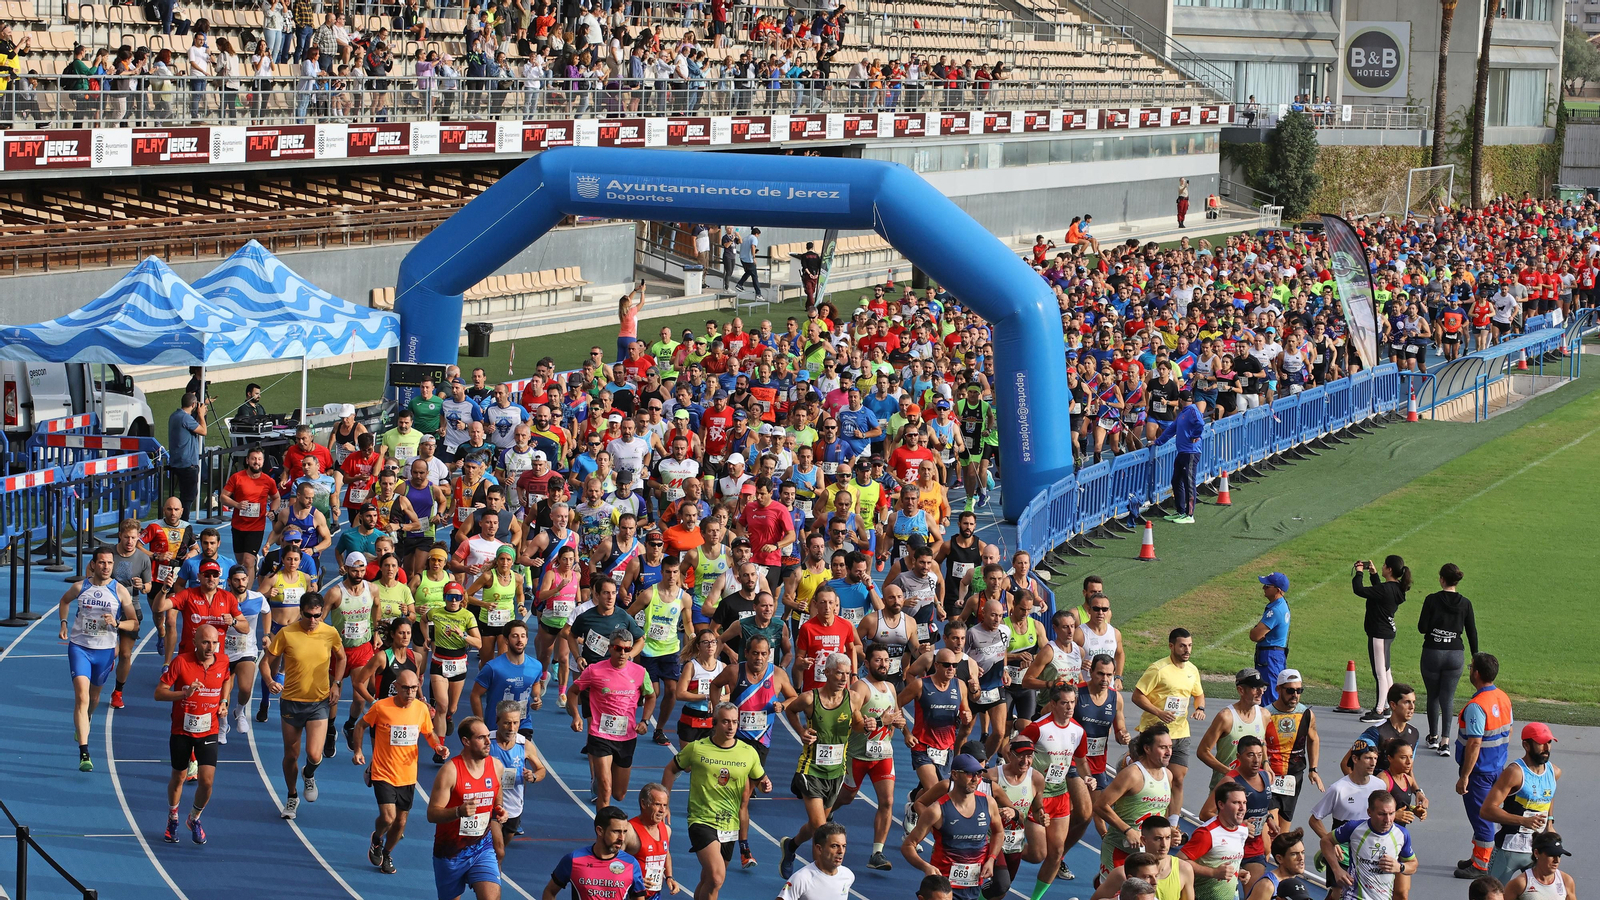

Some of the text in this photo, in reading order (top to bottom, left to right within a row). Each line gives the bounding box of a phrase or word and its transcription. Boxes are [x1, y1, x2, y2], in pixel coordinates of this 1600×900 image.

[1351, 47, 1397, 68] B&B
[1356, 69, 1390, 78] HOTELS
[249, 136, 276, 151] PLAY
[351, 132, 375, 146] PLAY
[9, 141, 42, 158] PLAY
[136, 138, 165, 153] PLAY
[605, 179, 840, 200] Ayuntamiento de Jerez
[606, 191, 673, 203] Deportes
[29, 368, 47, 379] gescon
[1016, 372, 1031, 462] deportes@aytojerez.es
[82, 598, 111, 608] LEBRIJA
[554, 604, 568, 612] 1002
[85, 622, 97, 631] 156
[587, 635, 599, 645] 851
[1088, 648, 1114, 656] bathco
[701, 682, 710, 691] 73
[1167, 701, 1179, 709] 606
[188, 719, 197, 727] 83
[604, 719, 614, 728] 65
[741, 715, 756, 724] 473
[393, 731, 407, 739] 928
[819, 749, 832, 758] 221
[869, 745, 882, 753] 490
[700, 756, 746, 768] Paparunners
[1050, 768, 1064, 777] 965
[463, 820, 478, 829] 330
[953, 870, 969, 879] 669
[578, 877, 625, 888] GADEIRAS
[587, 888, 617, 898] SPORT
